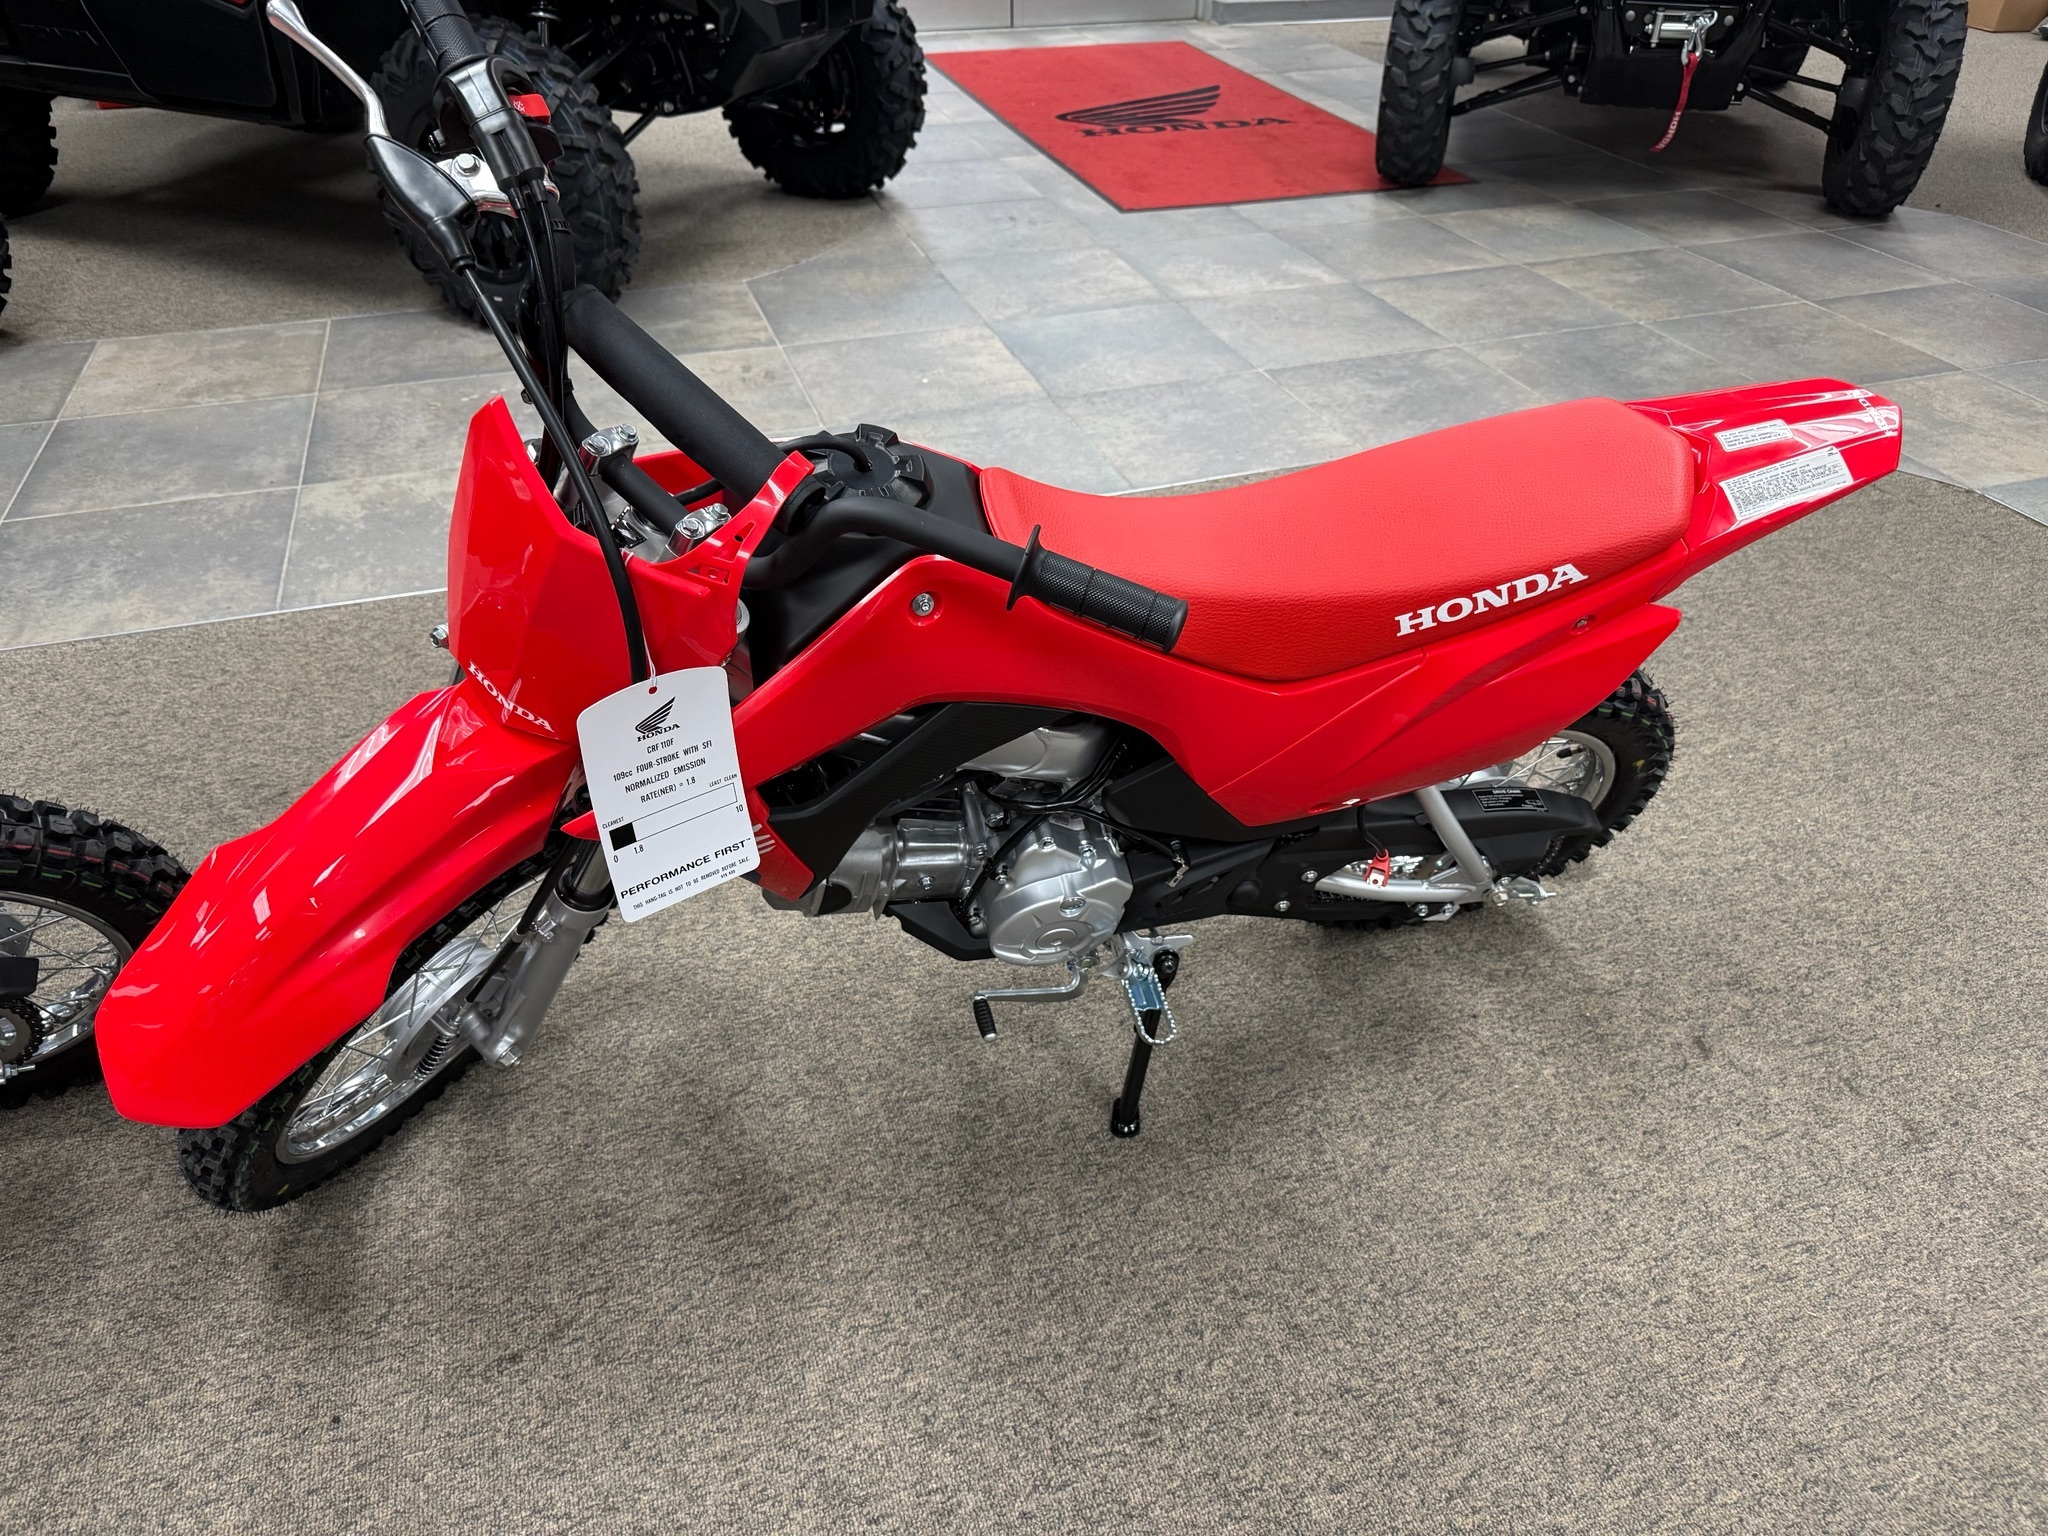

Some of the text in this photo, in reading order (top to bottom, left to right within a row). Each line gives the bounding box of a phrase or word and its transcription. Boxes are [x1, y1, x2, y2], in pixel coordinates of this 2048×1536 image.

[1076, 118, 1297, 137] HONDA
[1394, 563, 1589, 637] HONDA
[468, 659, 555, 733] HONDA
[637, 723, 681, 742] HONDA
[646, 738, 675, 754] CRF 110F
[613, 740, 712, 782] 109cc FOUR-STROKE WITH SFI
[624, 757, 706, 793] NORMALIZED EMISSION
[709, 773, 738, 788] LEAST CLEAN
[640, 783, 677, 804] RATE(NER)
[686, 776, 696, 787] 1.8
[735, 804, 744, 814] 10
[602, 816, 625, 829] CLEANEST
[613, 844, 644, 864] 0 1.8
[620, 855, 711, 899] PERFORMANCE
[633, 901, 644, 910] THIS
[645, 892, 667, 905] HANG-TAG
[675, 884, 684, 892] NOT
[701, 868, 720, 881] REMOVED
[722, 861, 737, 872] BEFORE
